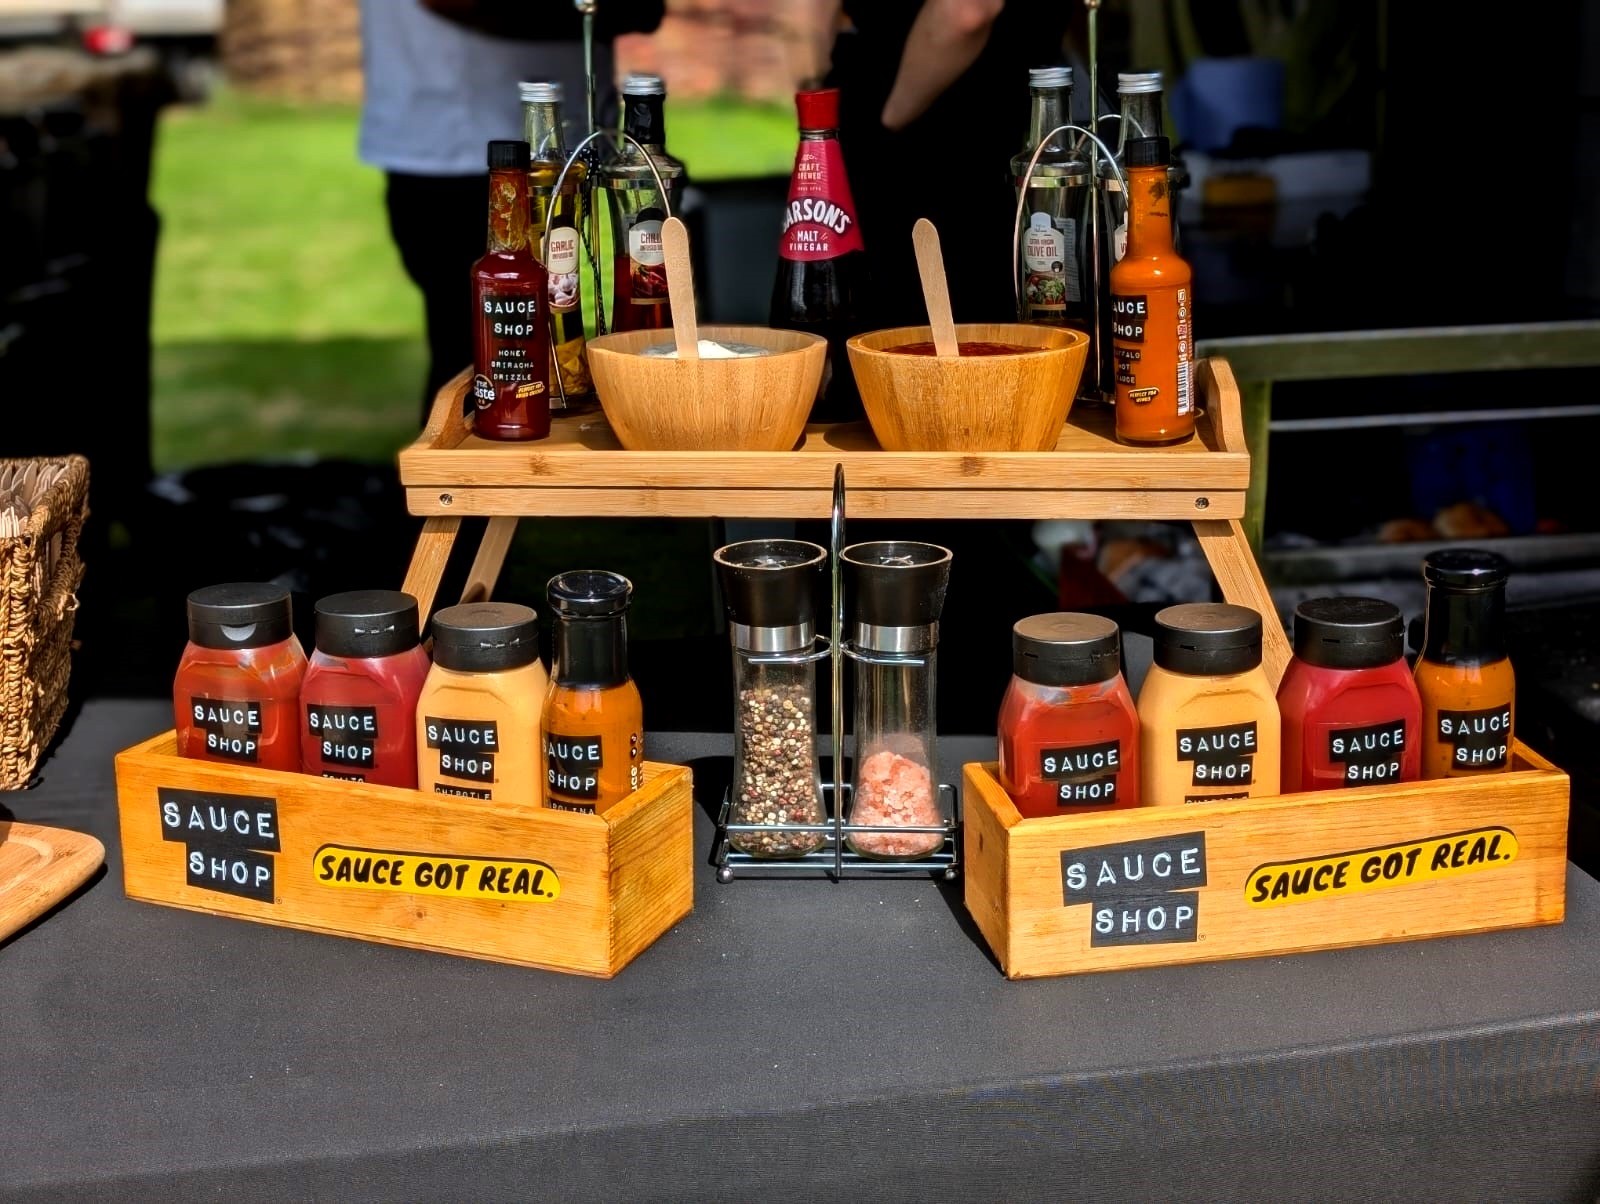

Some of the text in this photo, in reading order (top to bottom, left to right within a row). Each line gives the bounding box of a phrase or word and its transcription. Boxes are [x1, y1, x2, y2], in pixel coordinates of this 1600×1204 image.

[551, 240, 574, 252] GARLIC
[640, 233, 662, 243] CHILL
[797, 231, 818, 241] MALT
[790, 243, 828, 251] VINEGAR
[1027, 245, 1059, 257] OLIVE OIL
[484, 301, 536, 314] SAUCE
[1112, 301, 1146, 314] AUCE
[494, 322, 534, 336] SHOP
[194, 705, 259, 726] SAUCE
[309, 712, 375, 731] SAUCE
[1440, 711, 1510, 735] SAUCE
[207, 733, 256, 755] SHOP
[428, 725, 496, 745] SAUCE
[1180, 730, 1255, 753] SAUCE
[1332, 729, 1404, 754] SAUCE
[323, 741, 372, 761] SHOP
[1044, 749, 1119, 773] SAUCE
[1456, 745, 1507, 762] SHOP
[442, 754, 492, 775] SHOP
[1196, 763, 1250, 780] SHOP
[1348, 762, 1399, 779] SHOP
[548, 769, 596, 791] SHOP
[1060, 783, 1115, 800] SHOP
[163, 801, 274, 839] SAUCE
[189, 851, 271, 888] SHOP
[319, 855, 554, 898] SAUCE GOT REAL.
[1066, 847, 1201, 890] SAUCE
[1252, 834, 1511, 903] SAUCE GOT REAL.
[1095, 904, 1194, 934] SHOP
